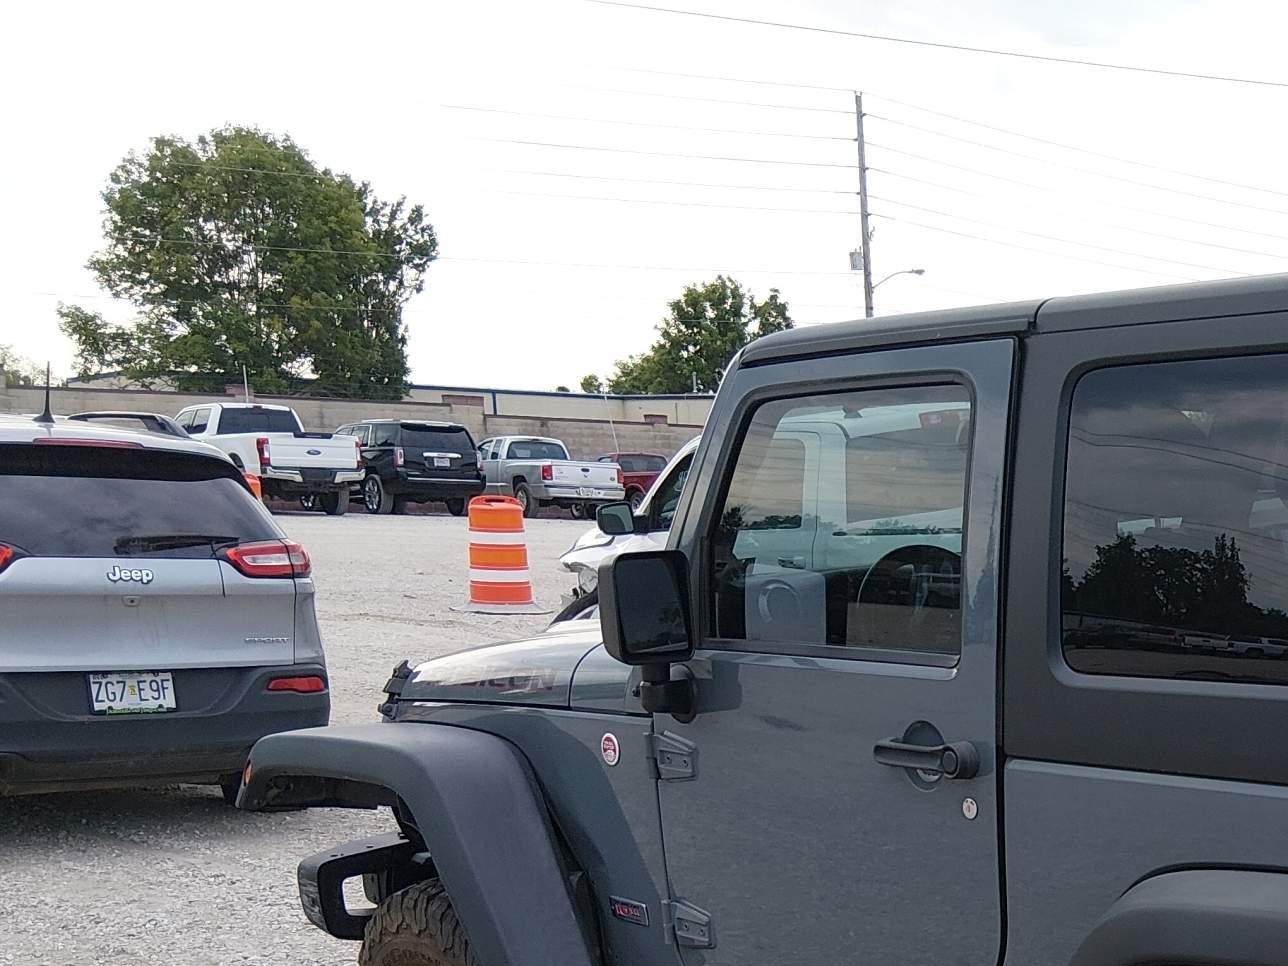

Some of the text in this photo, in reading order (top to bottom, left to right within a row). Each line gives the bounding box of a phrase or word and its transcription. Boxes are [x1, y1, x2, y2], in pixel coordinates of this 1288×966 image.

[107, 566, 154, 584] Jeep
[92, 679, 170, 703] ZG7 E9F
